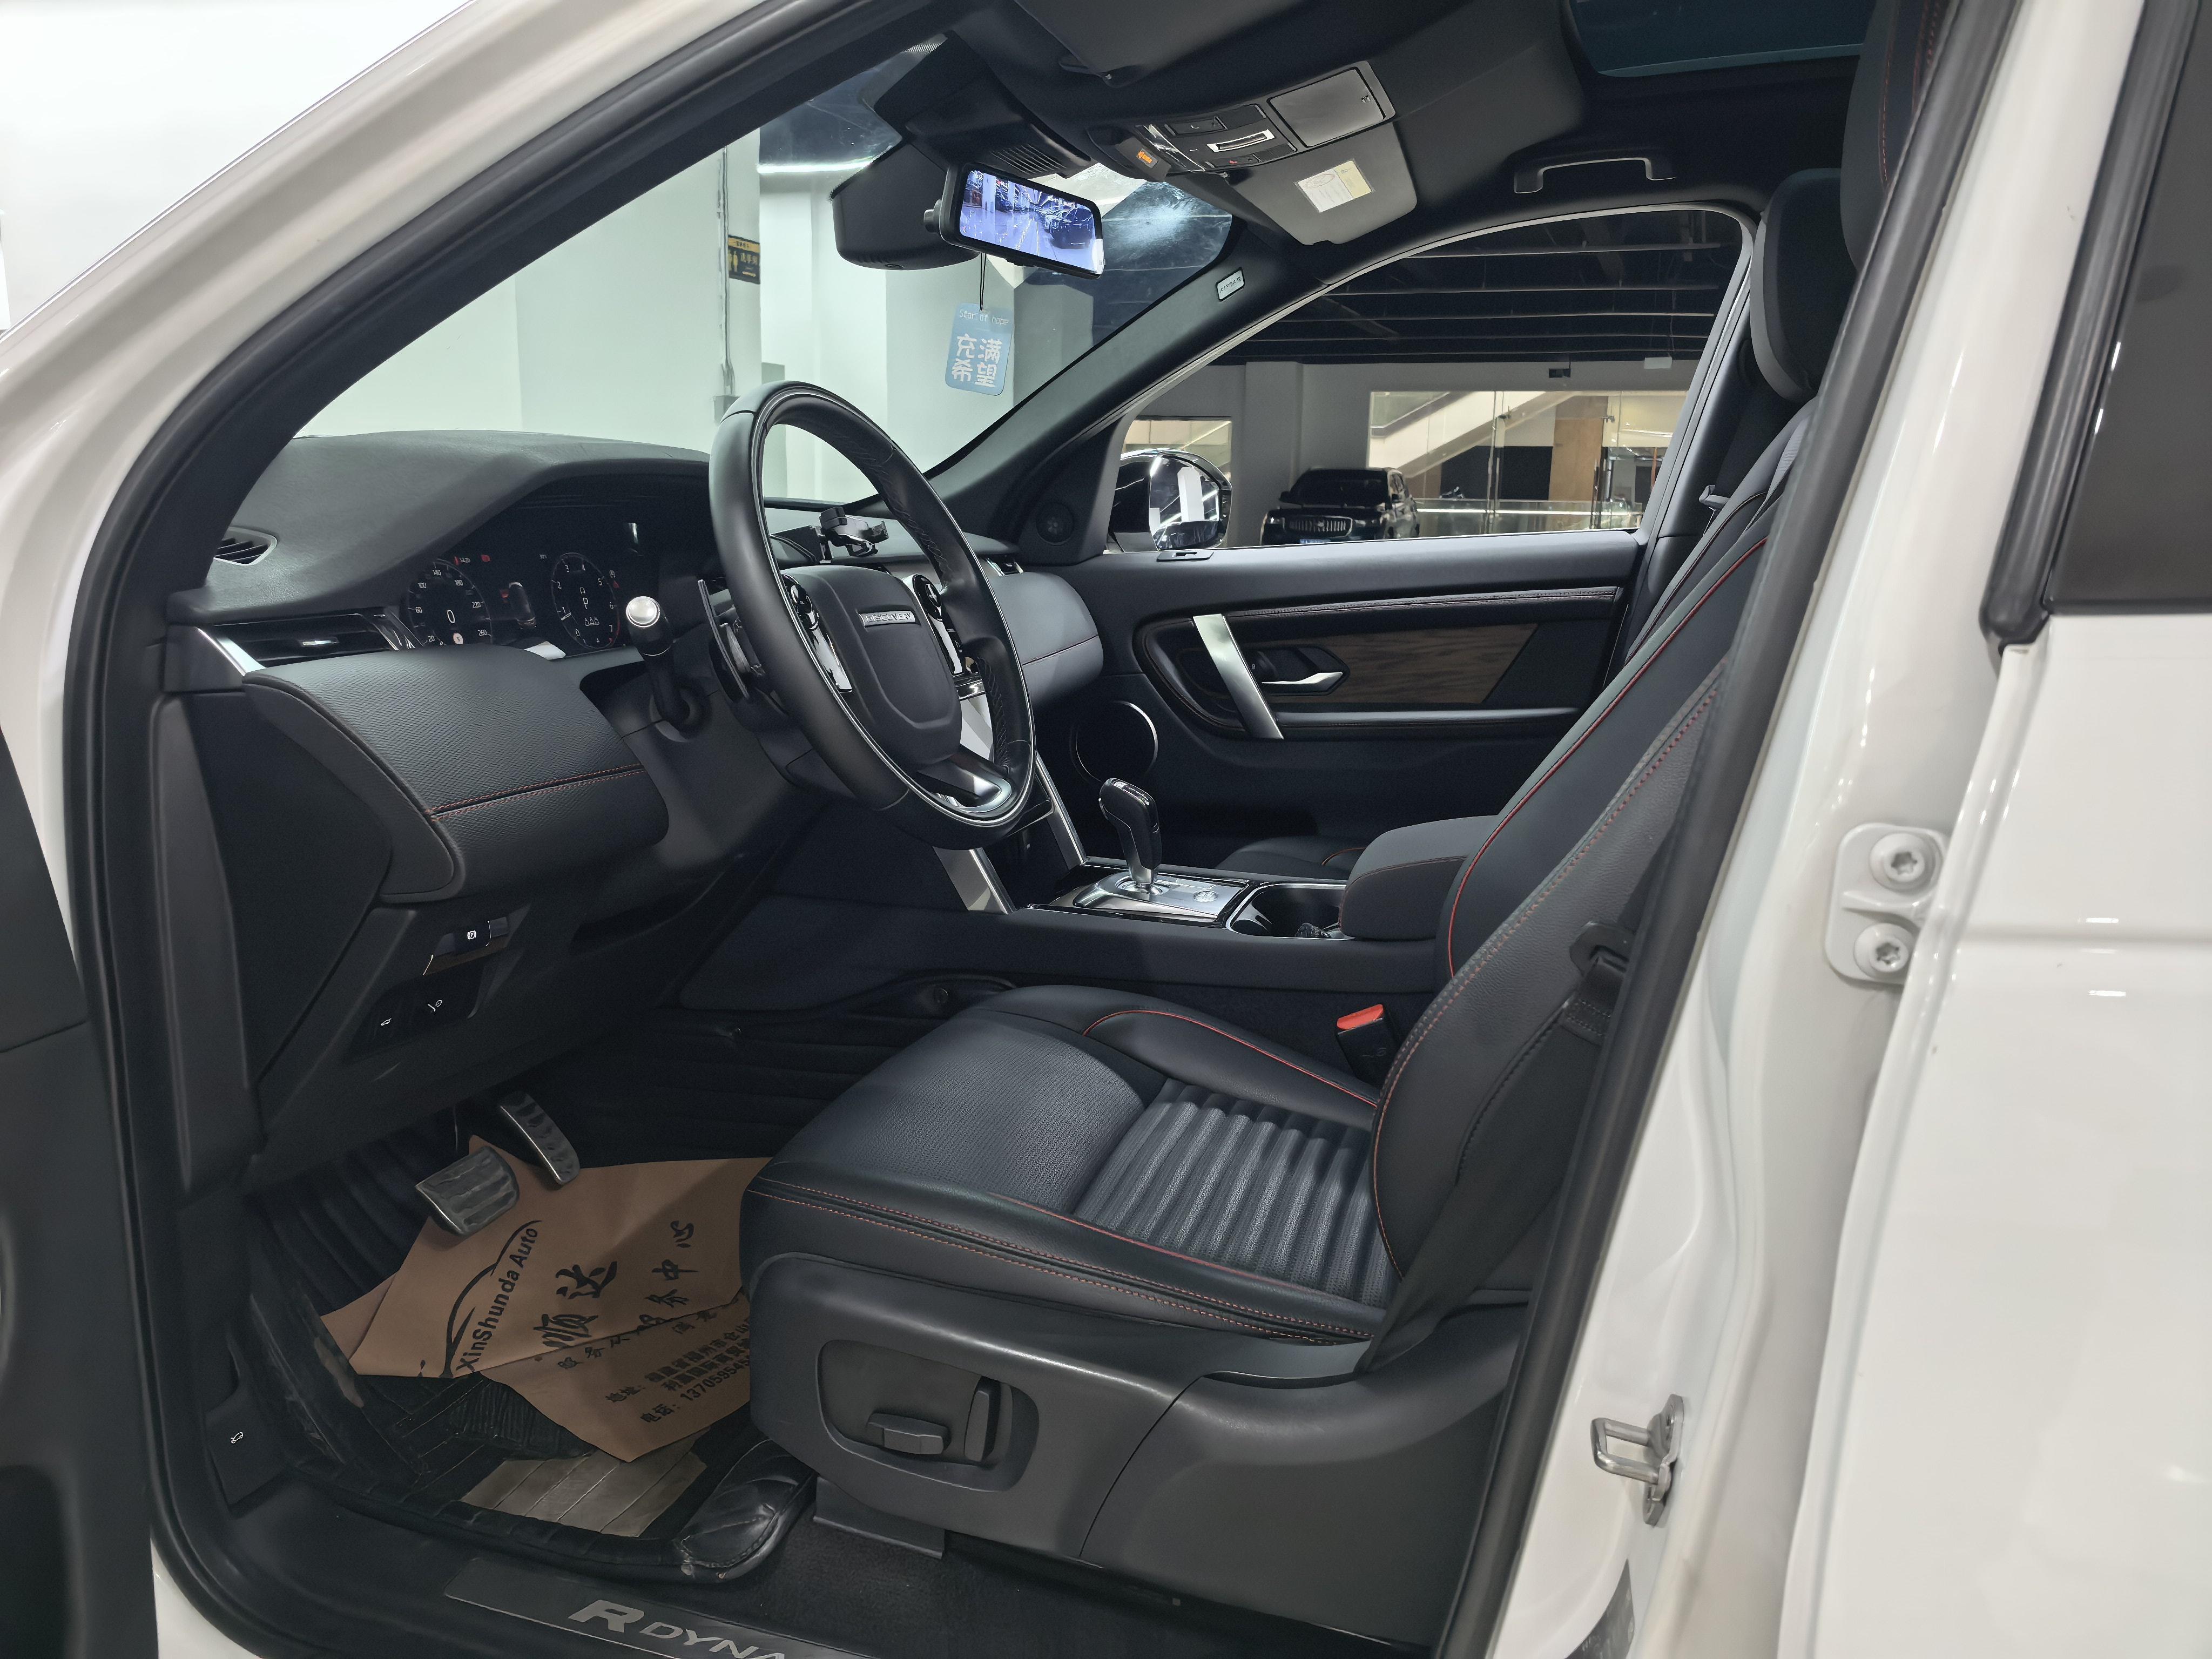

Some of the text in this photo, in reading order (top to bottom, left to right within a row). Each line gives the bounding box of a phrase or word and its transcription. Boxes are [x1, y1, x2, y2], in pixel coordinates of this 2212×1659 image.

[957, 333, 1002, 364] 充满
[952, 358, 997, 388] 希望
[447, 609, 455, 623] 0
[583, 597, 589, 610] P
[865, 613, 912, 622] DISCOVERY
[456, 1228, 538, 1372] XinShunda Auto
[568, 1600, 645, 1633] R
